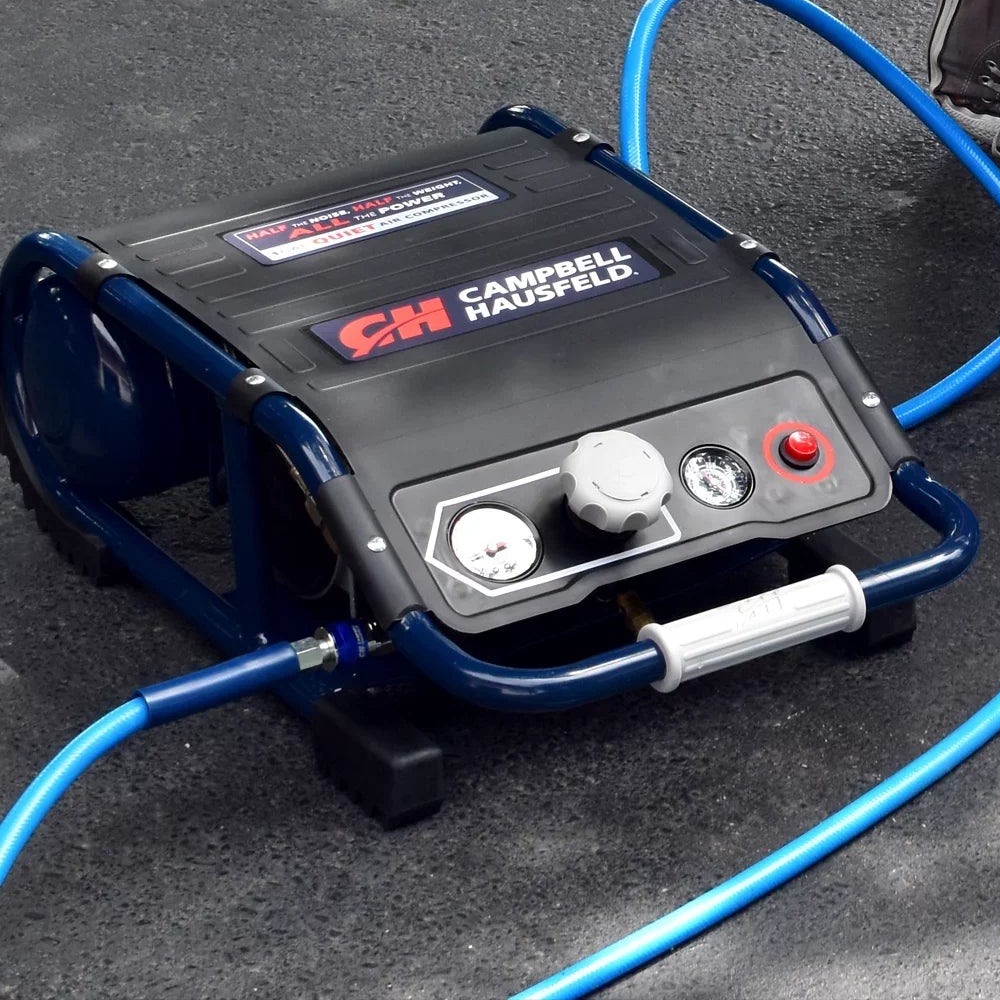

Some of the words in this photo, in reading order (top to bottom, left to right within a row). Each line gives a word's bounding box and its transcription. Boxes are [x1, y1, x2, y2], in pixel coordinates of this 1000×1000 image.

[245, 223, 288, 241] HALF
[291, 220, 308, 229] THE
[352, 196, 392, 212] HALF
[396, 192, 411, 201] THE
[289, 218, 350, 240] ALL
[353, 211, 376, 221] THE
[378, 192, 446, 215] POWER
[313, 224, 376, 245] QUIET
[379, 218, 402, 227] AIR
[405, 193, 489, 219] COMPRESSOR
[458, 246, 632, 304] CAMPBELL
